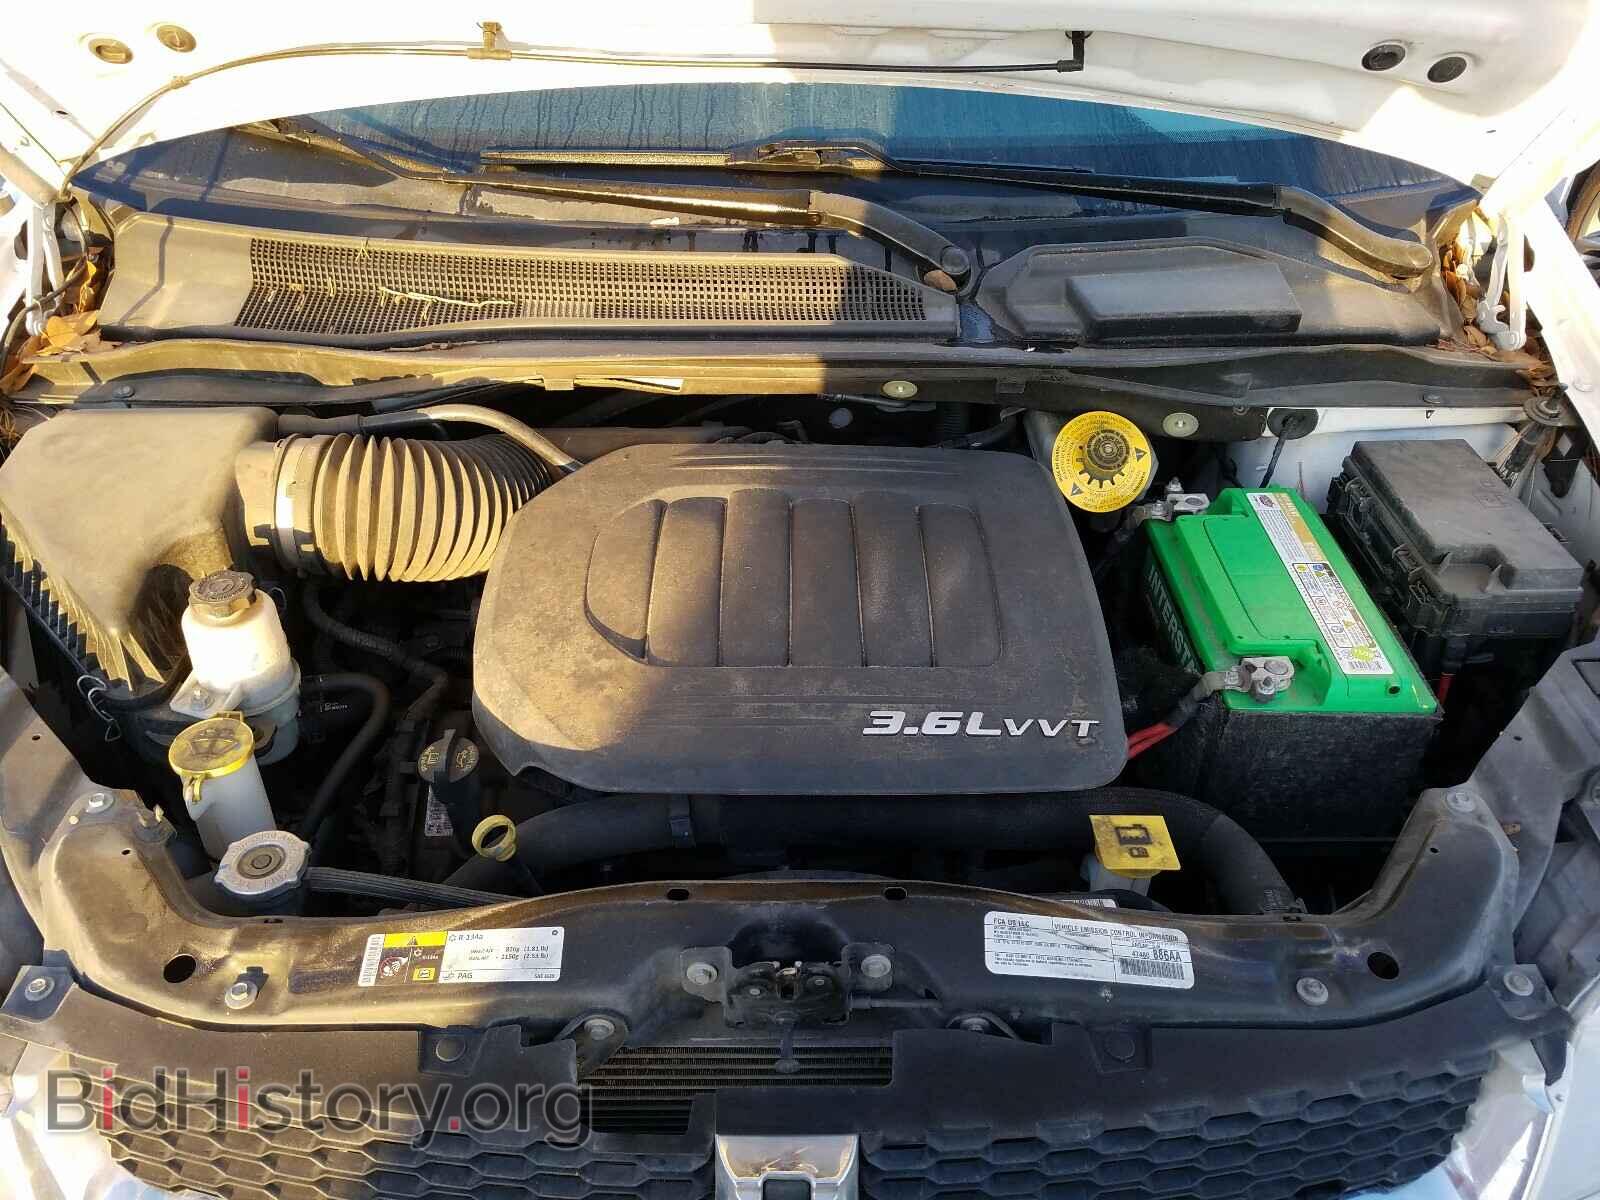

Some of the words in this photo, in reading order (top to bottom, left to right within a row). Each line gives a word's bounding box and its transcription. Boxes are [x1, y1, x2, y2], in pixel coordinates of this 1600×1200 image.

[1054, 923, 1079, 932] VEHICLE
[1080, 926, 1109, 936] EMISSION
[1110, 929, 1138, 938] CONTROL
[1138, 932, 1179, 943] INFORMATION
